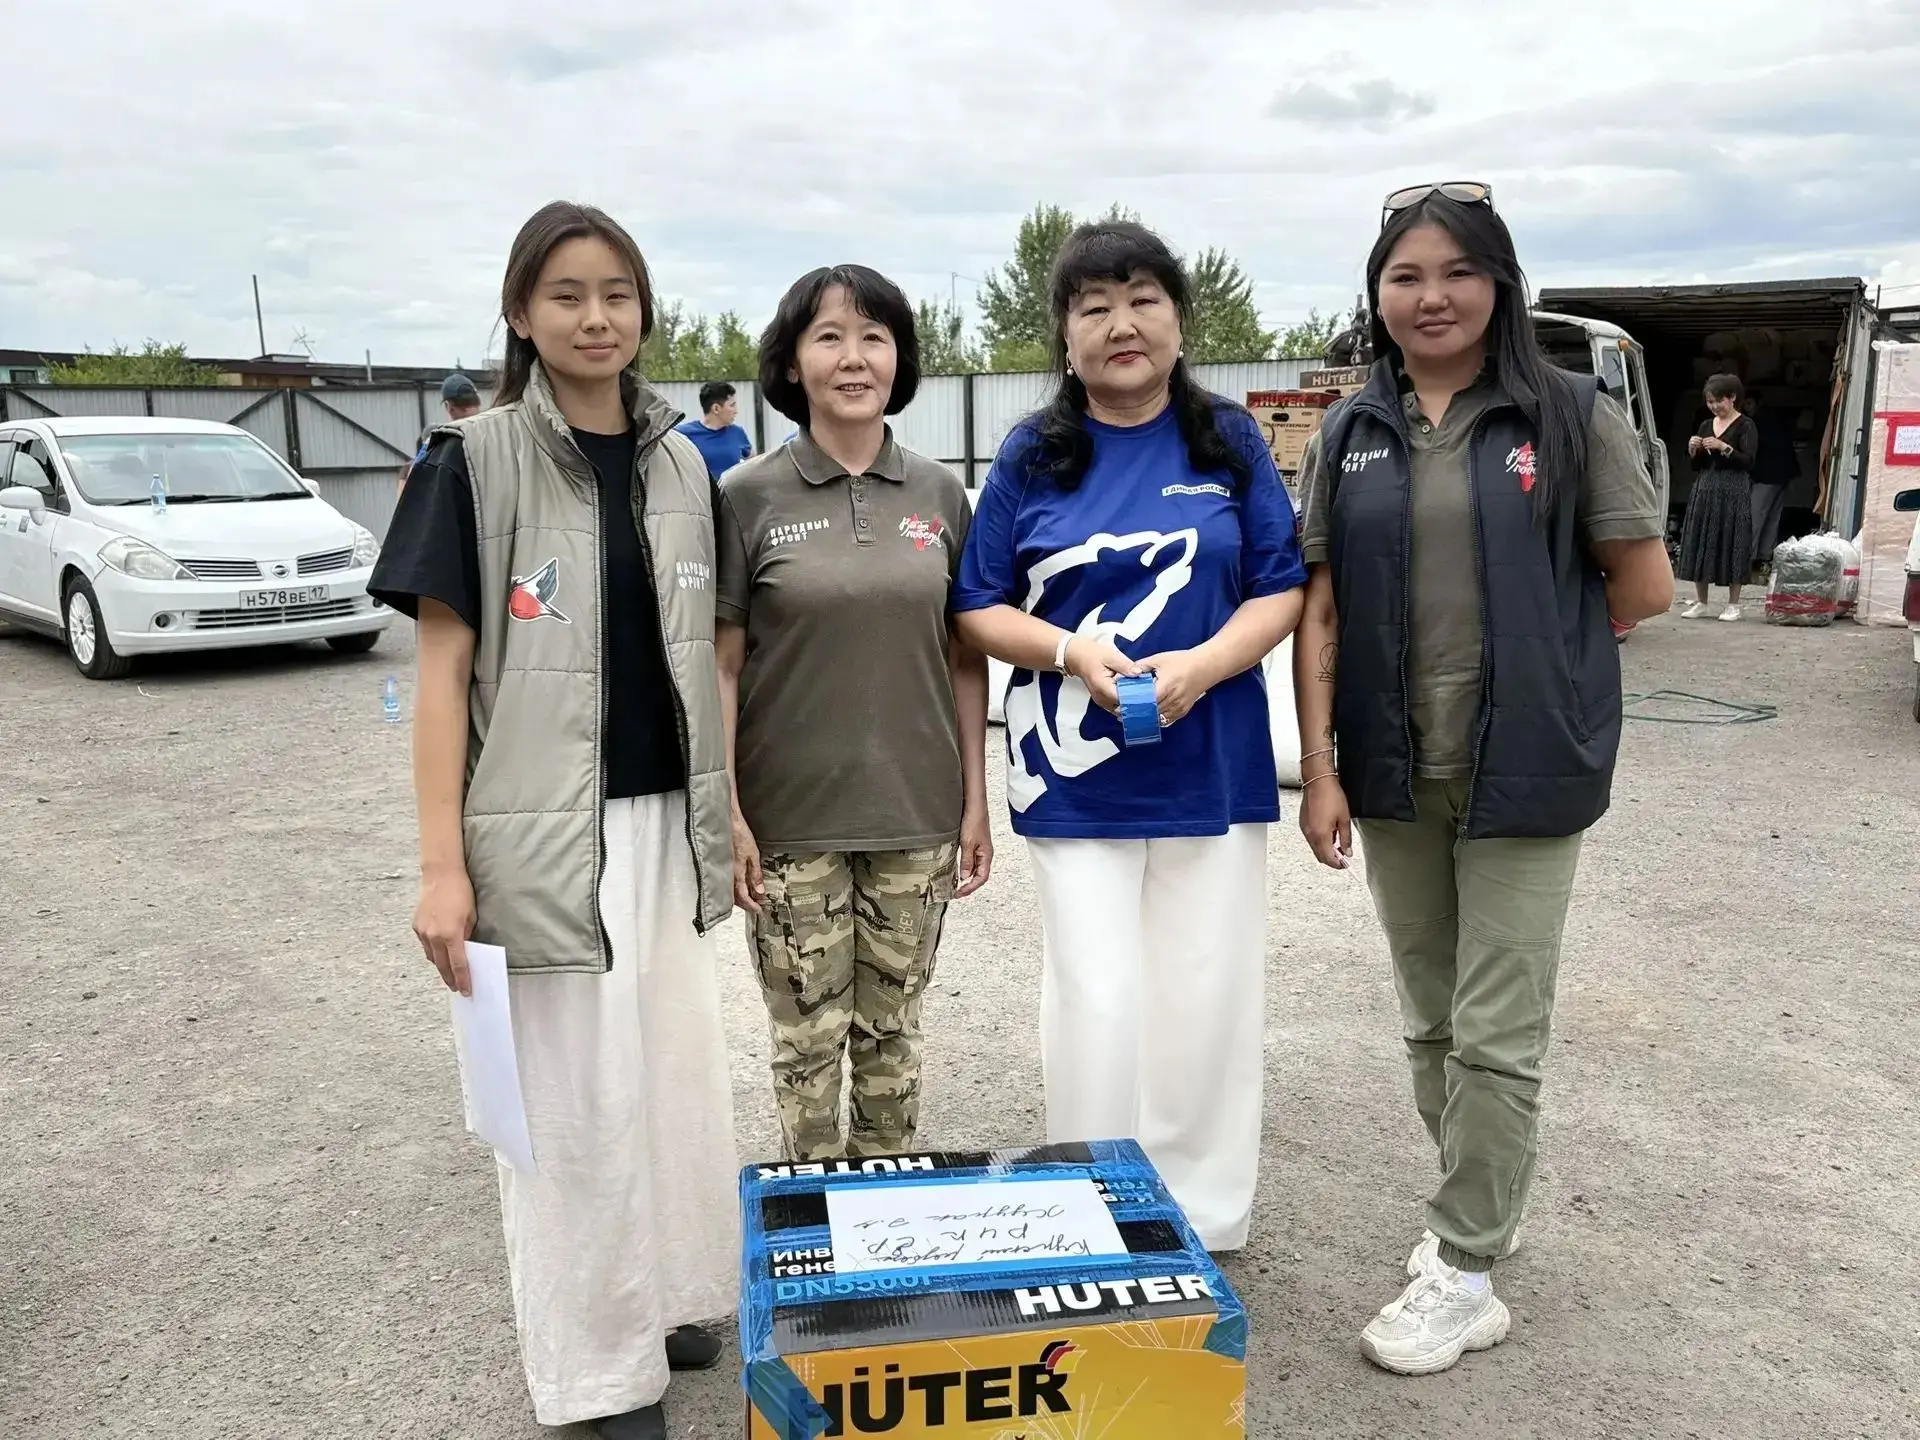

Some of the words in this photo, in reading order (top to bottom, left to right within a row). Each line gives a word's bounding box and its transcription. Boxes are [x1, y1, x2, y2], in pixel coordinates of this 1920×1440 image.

[1165, 486, 1199, 494] ЕДИНАЯ
[1200, 485, 1228, 495] РОССИЯ
[770, 517, 830, 538] НАРОДНЫЙ
[771, 531, 807, 546] ФРОНТ
[311, 586, 324, 600] 17
[977, 1233, 1092, 1261] Курский
[773, 1247, 833, 1263] инв
[774, 1262, 836, 1277] гене
